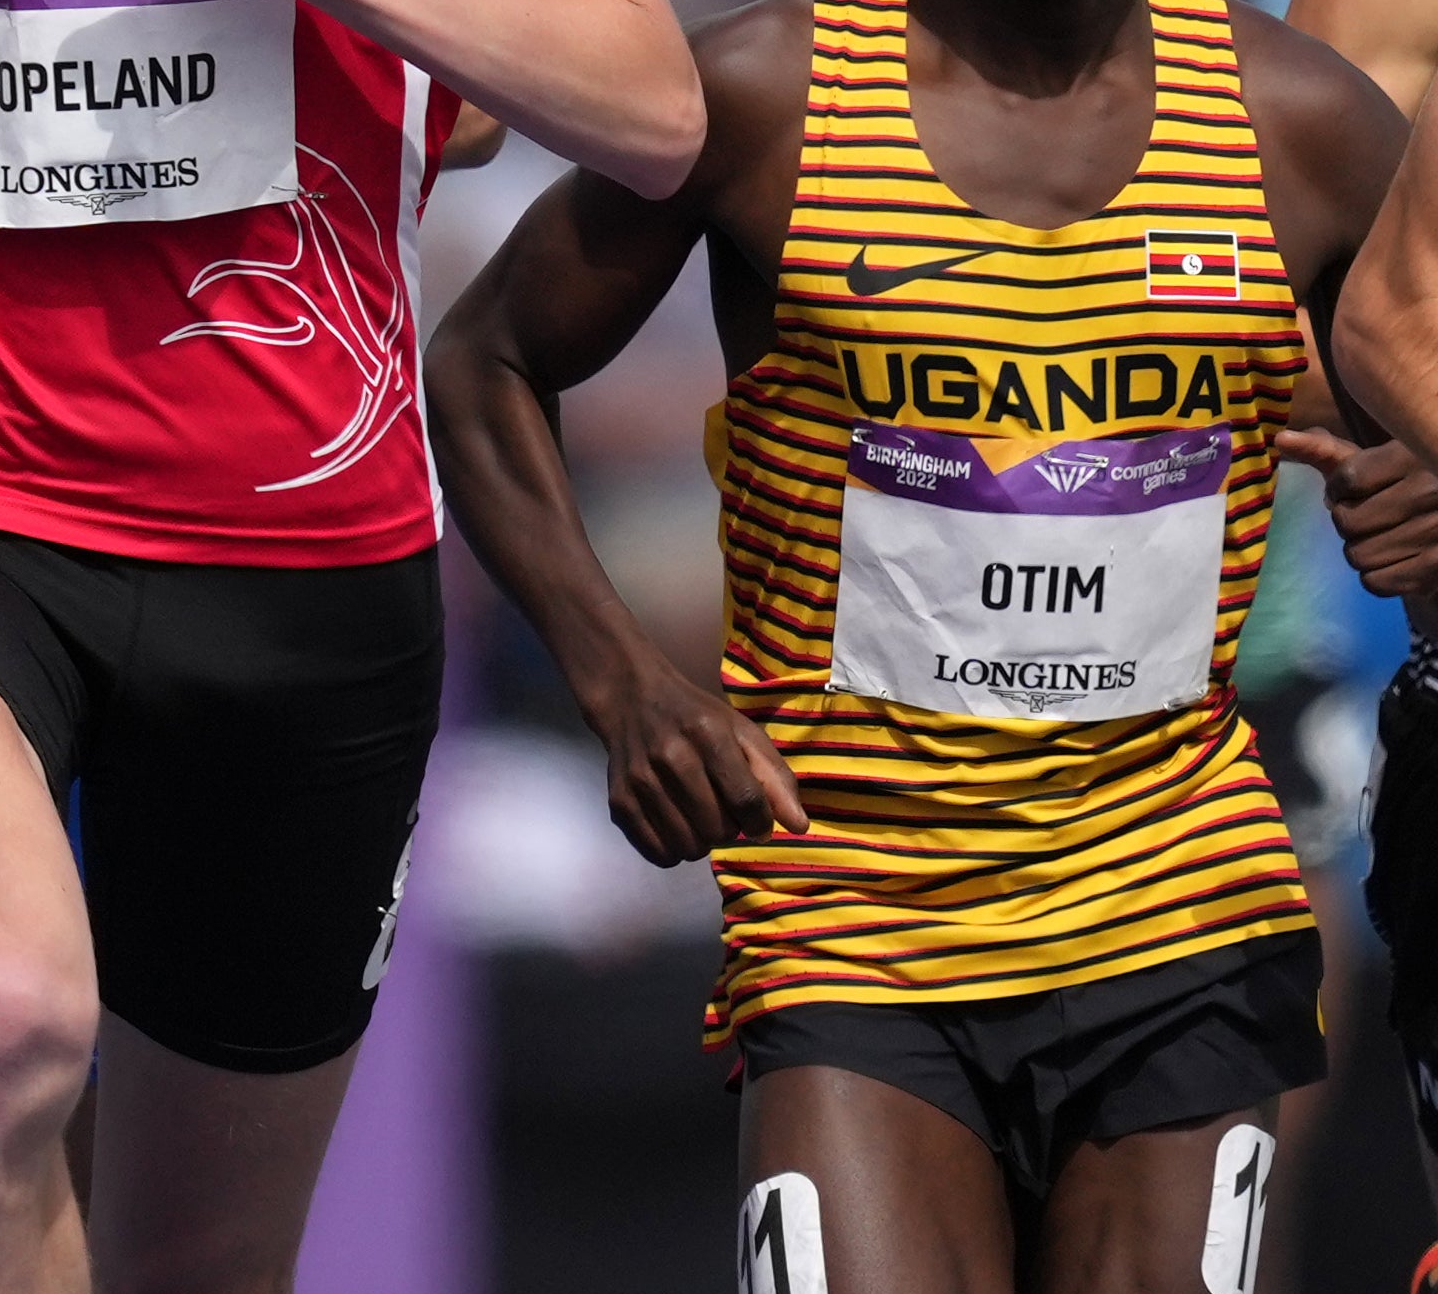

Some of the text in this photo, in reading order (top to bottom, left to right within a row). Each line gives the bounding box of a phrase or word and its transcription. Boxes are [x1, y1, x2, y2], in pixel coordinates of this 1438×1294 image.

[0, 157, 200, 194] LONGINES
[841, 349, 1223, 433] UGANDA
[866, 443, 972, 481] BIRMINGHAM
[895, 468, 938, 491] 2022
[1142, 467, 1188, 497] games
[981, 562, 1106, 614] OTIM
[934, 654, 1137, 691] LONGINES
